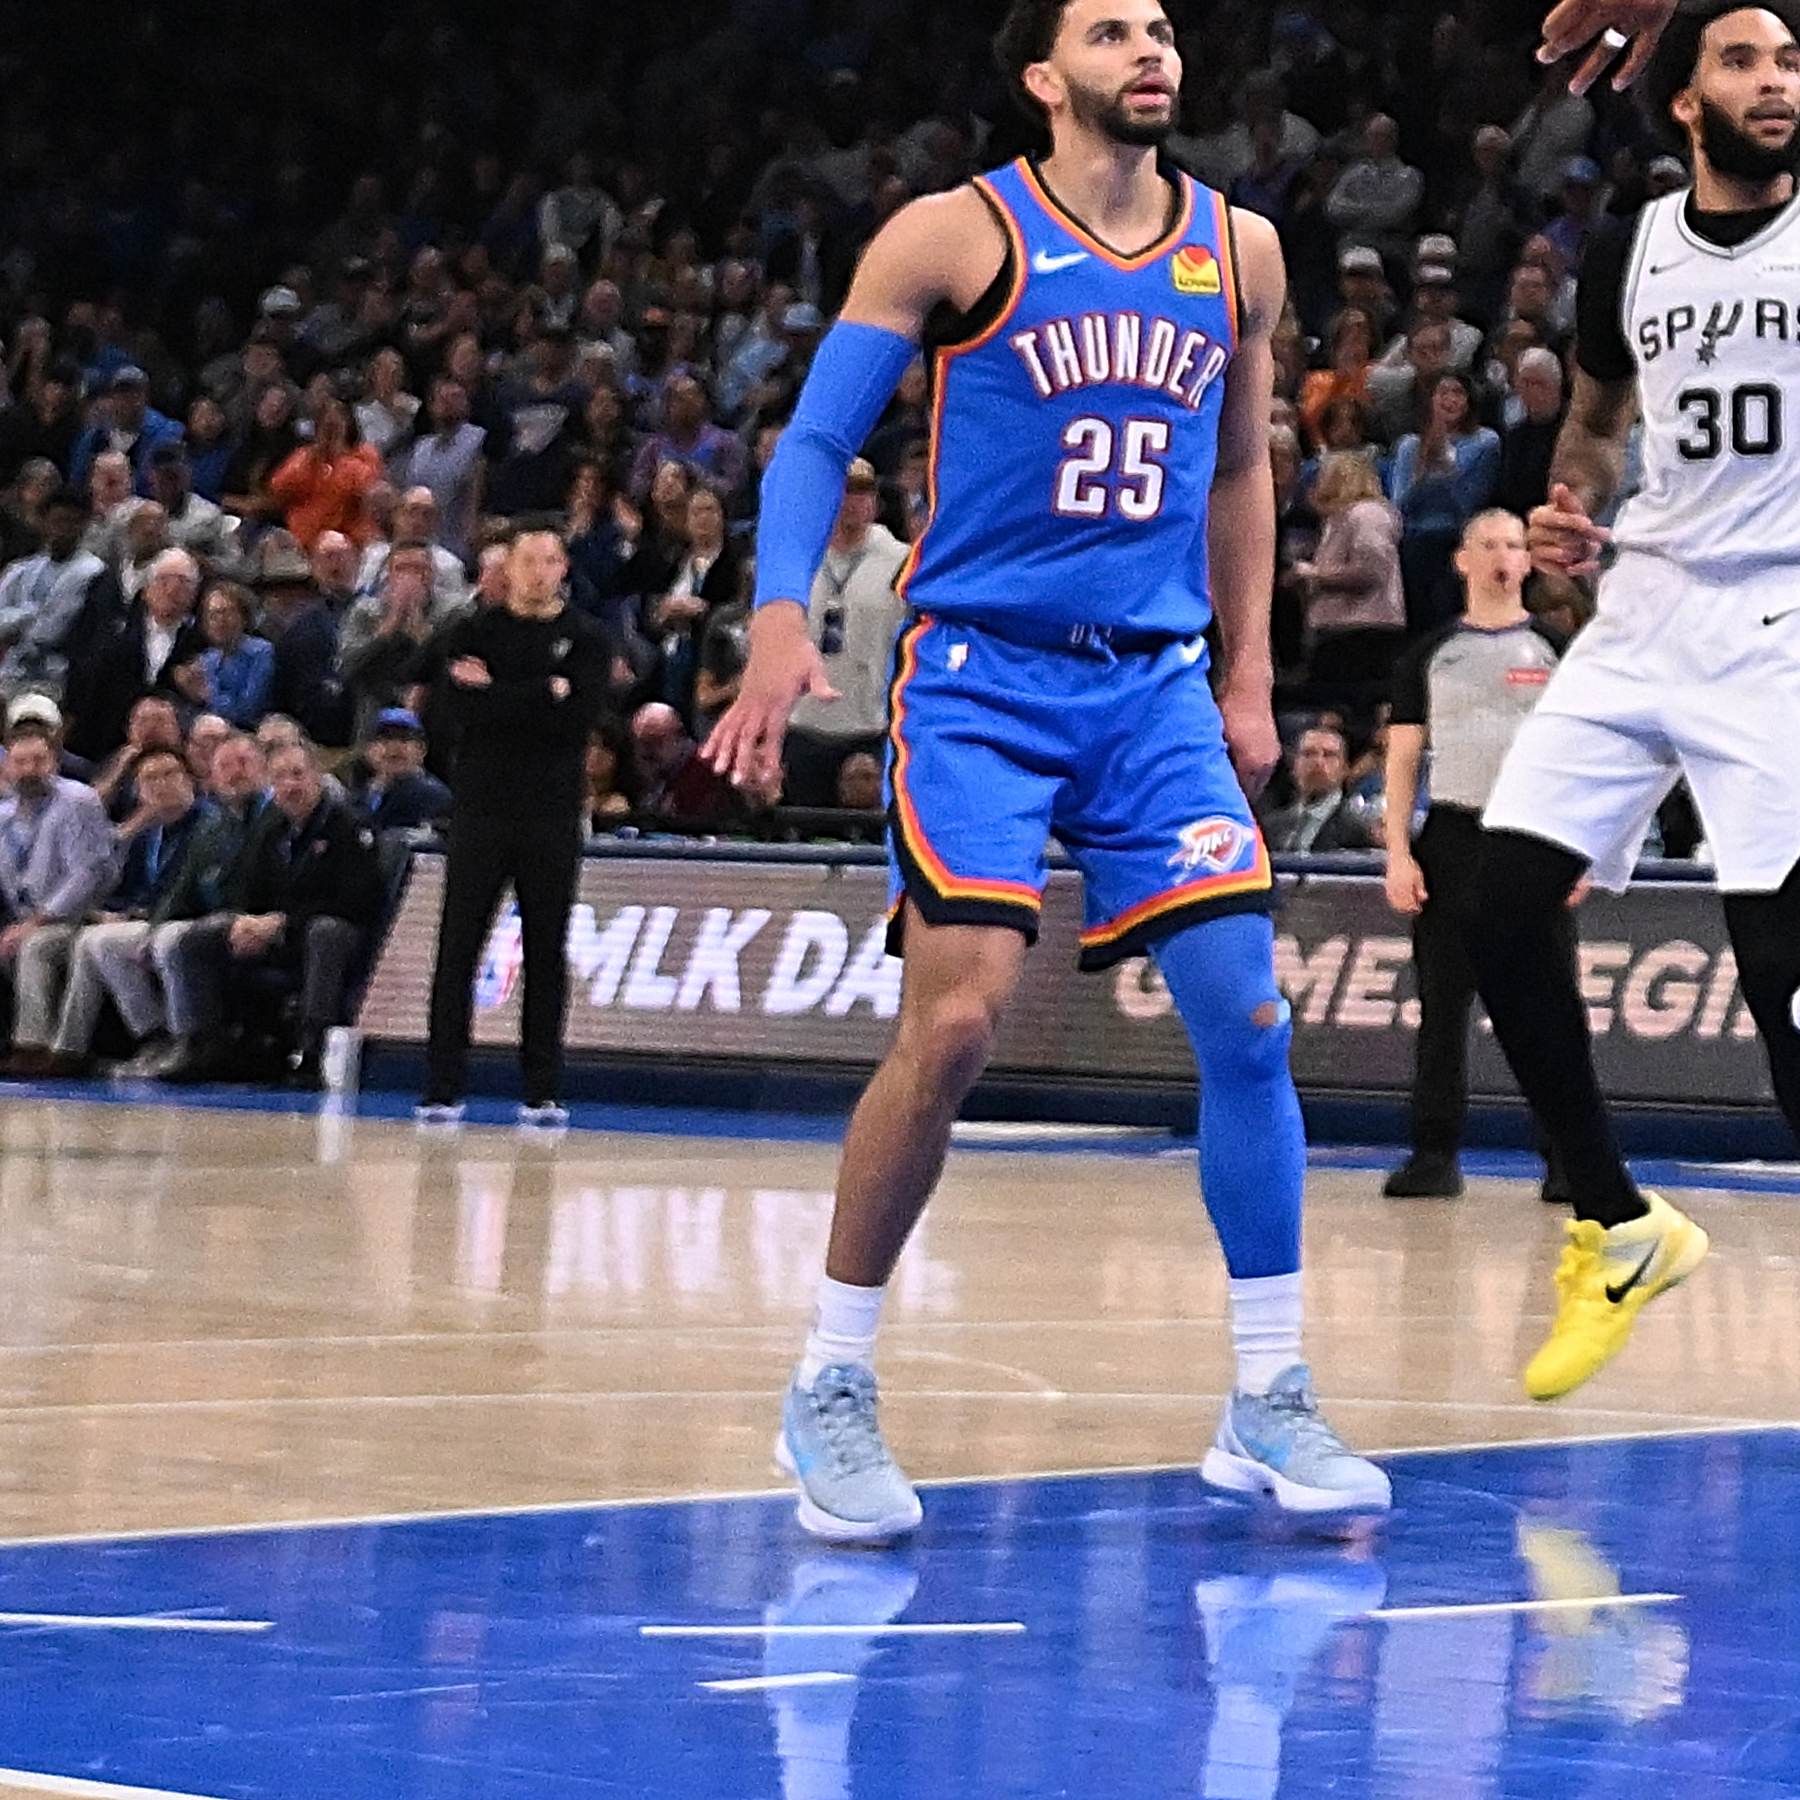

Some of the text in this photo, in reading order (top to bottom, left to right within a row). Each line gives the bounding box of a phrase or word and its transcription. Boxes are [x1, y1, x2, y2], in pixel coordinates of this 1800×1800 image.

[1009, 309, 1234, 412] THUNDER
[1052, 412, 1172, 522] 25
[1676, 382, 1786, 462] 30
[566, 902, 904, 1020] MLK DA
